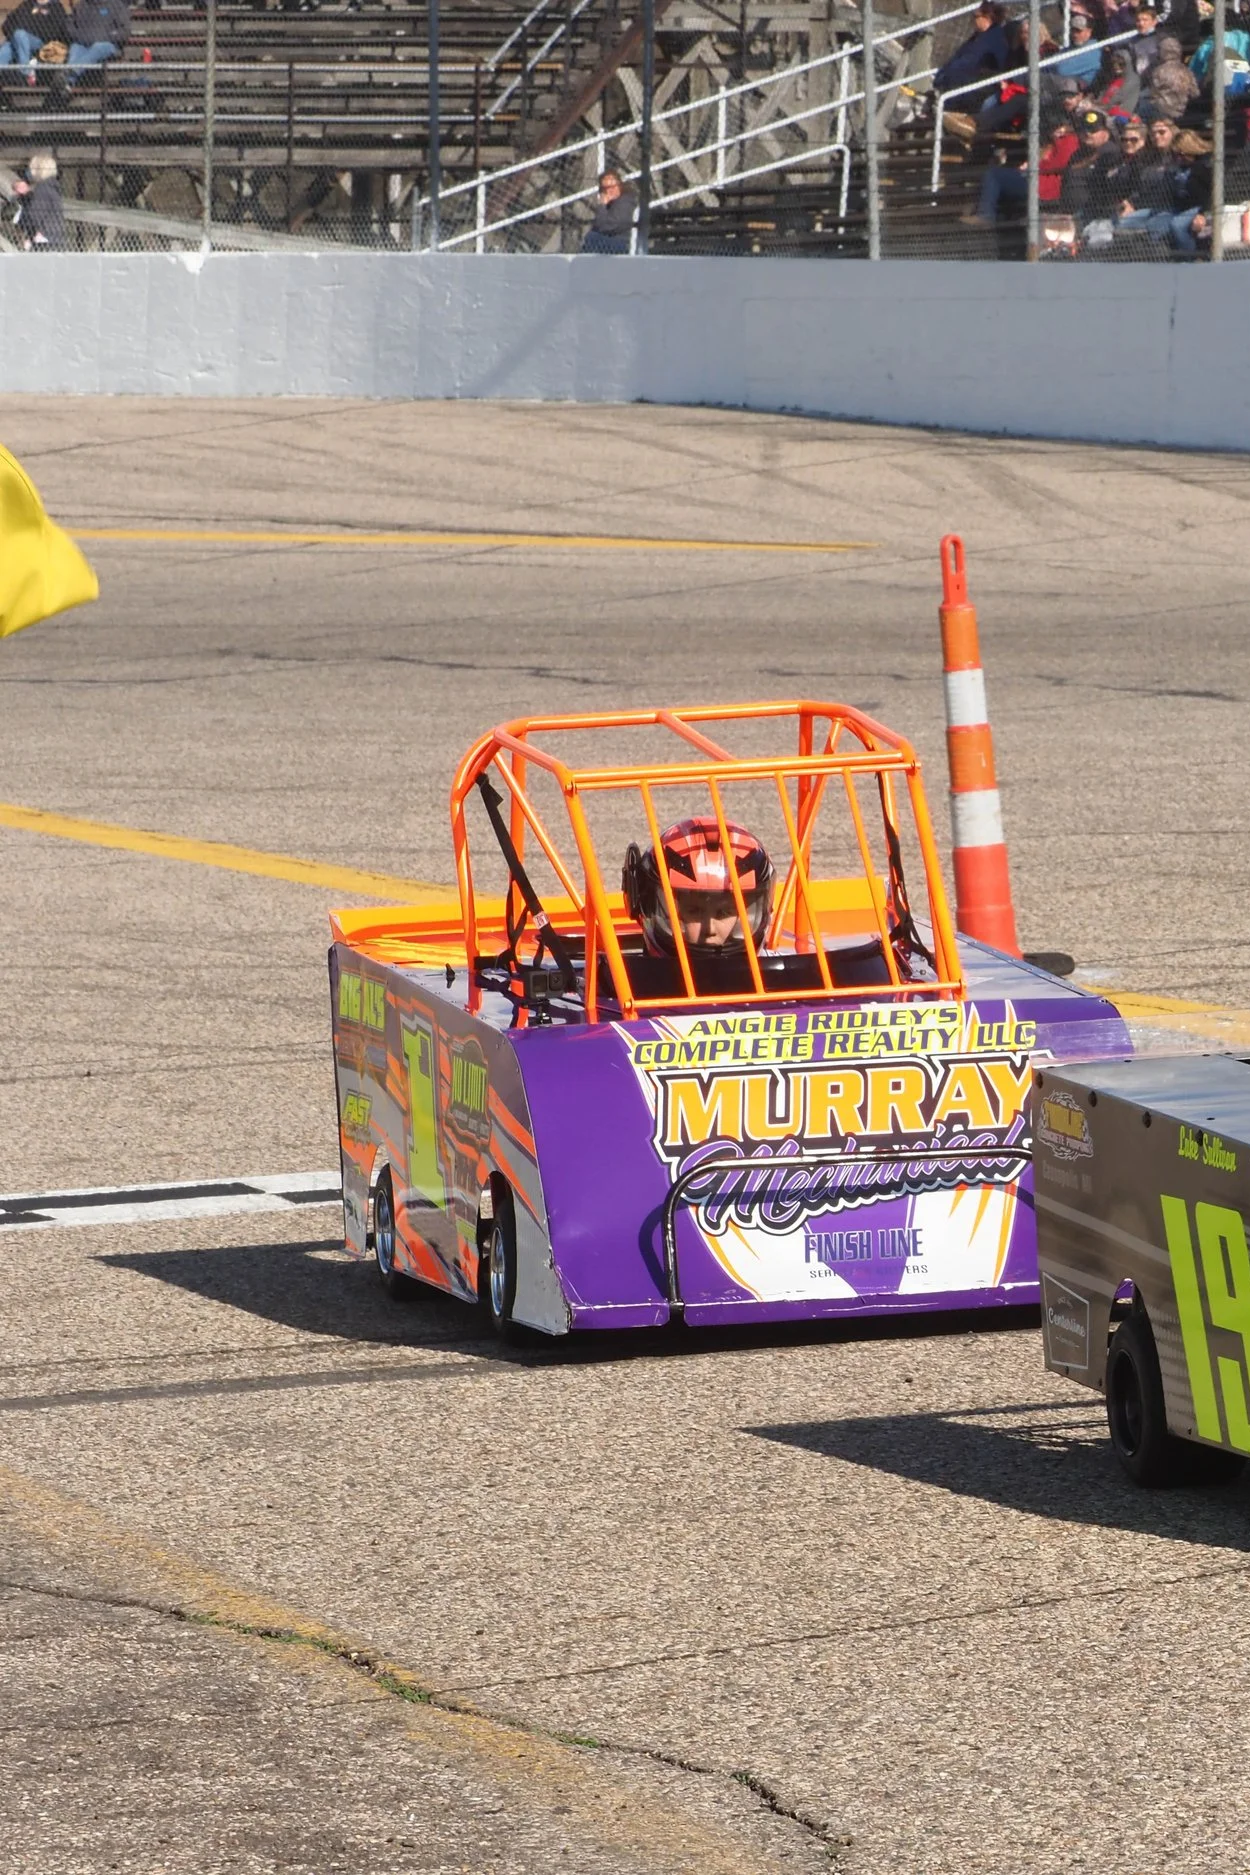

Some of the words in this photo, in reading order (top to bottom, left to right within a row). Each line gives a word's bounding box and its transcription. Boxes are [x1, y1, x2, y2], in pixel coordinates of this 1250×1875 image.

[633, 1034, 811, 1066] COMPLETE
[827, 1025, 962, 1058] REALTY
[975, 1020, 1037, 1050] LLC
[686, 1014, 796, 1038] ANGIE
[809, 1006, 961, 1032] RIDLEY'S
[402, 1028, 446, 1212] 1
[662, 1059, 1033, 1147] MURRAY
[804, 1230, 872, 1263] FINISH
[878, 1228, 924, 1258] LINE
